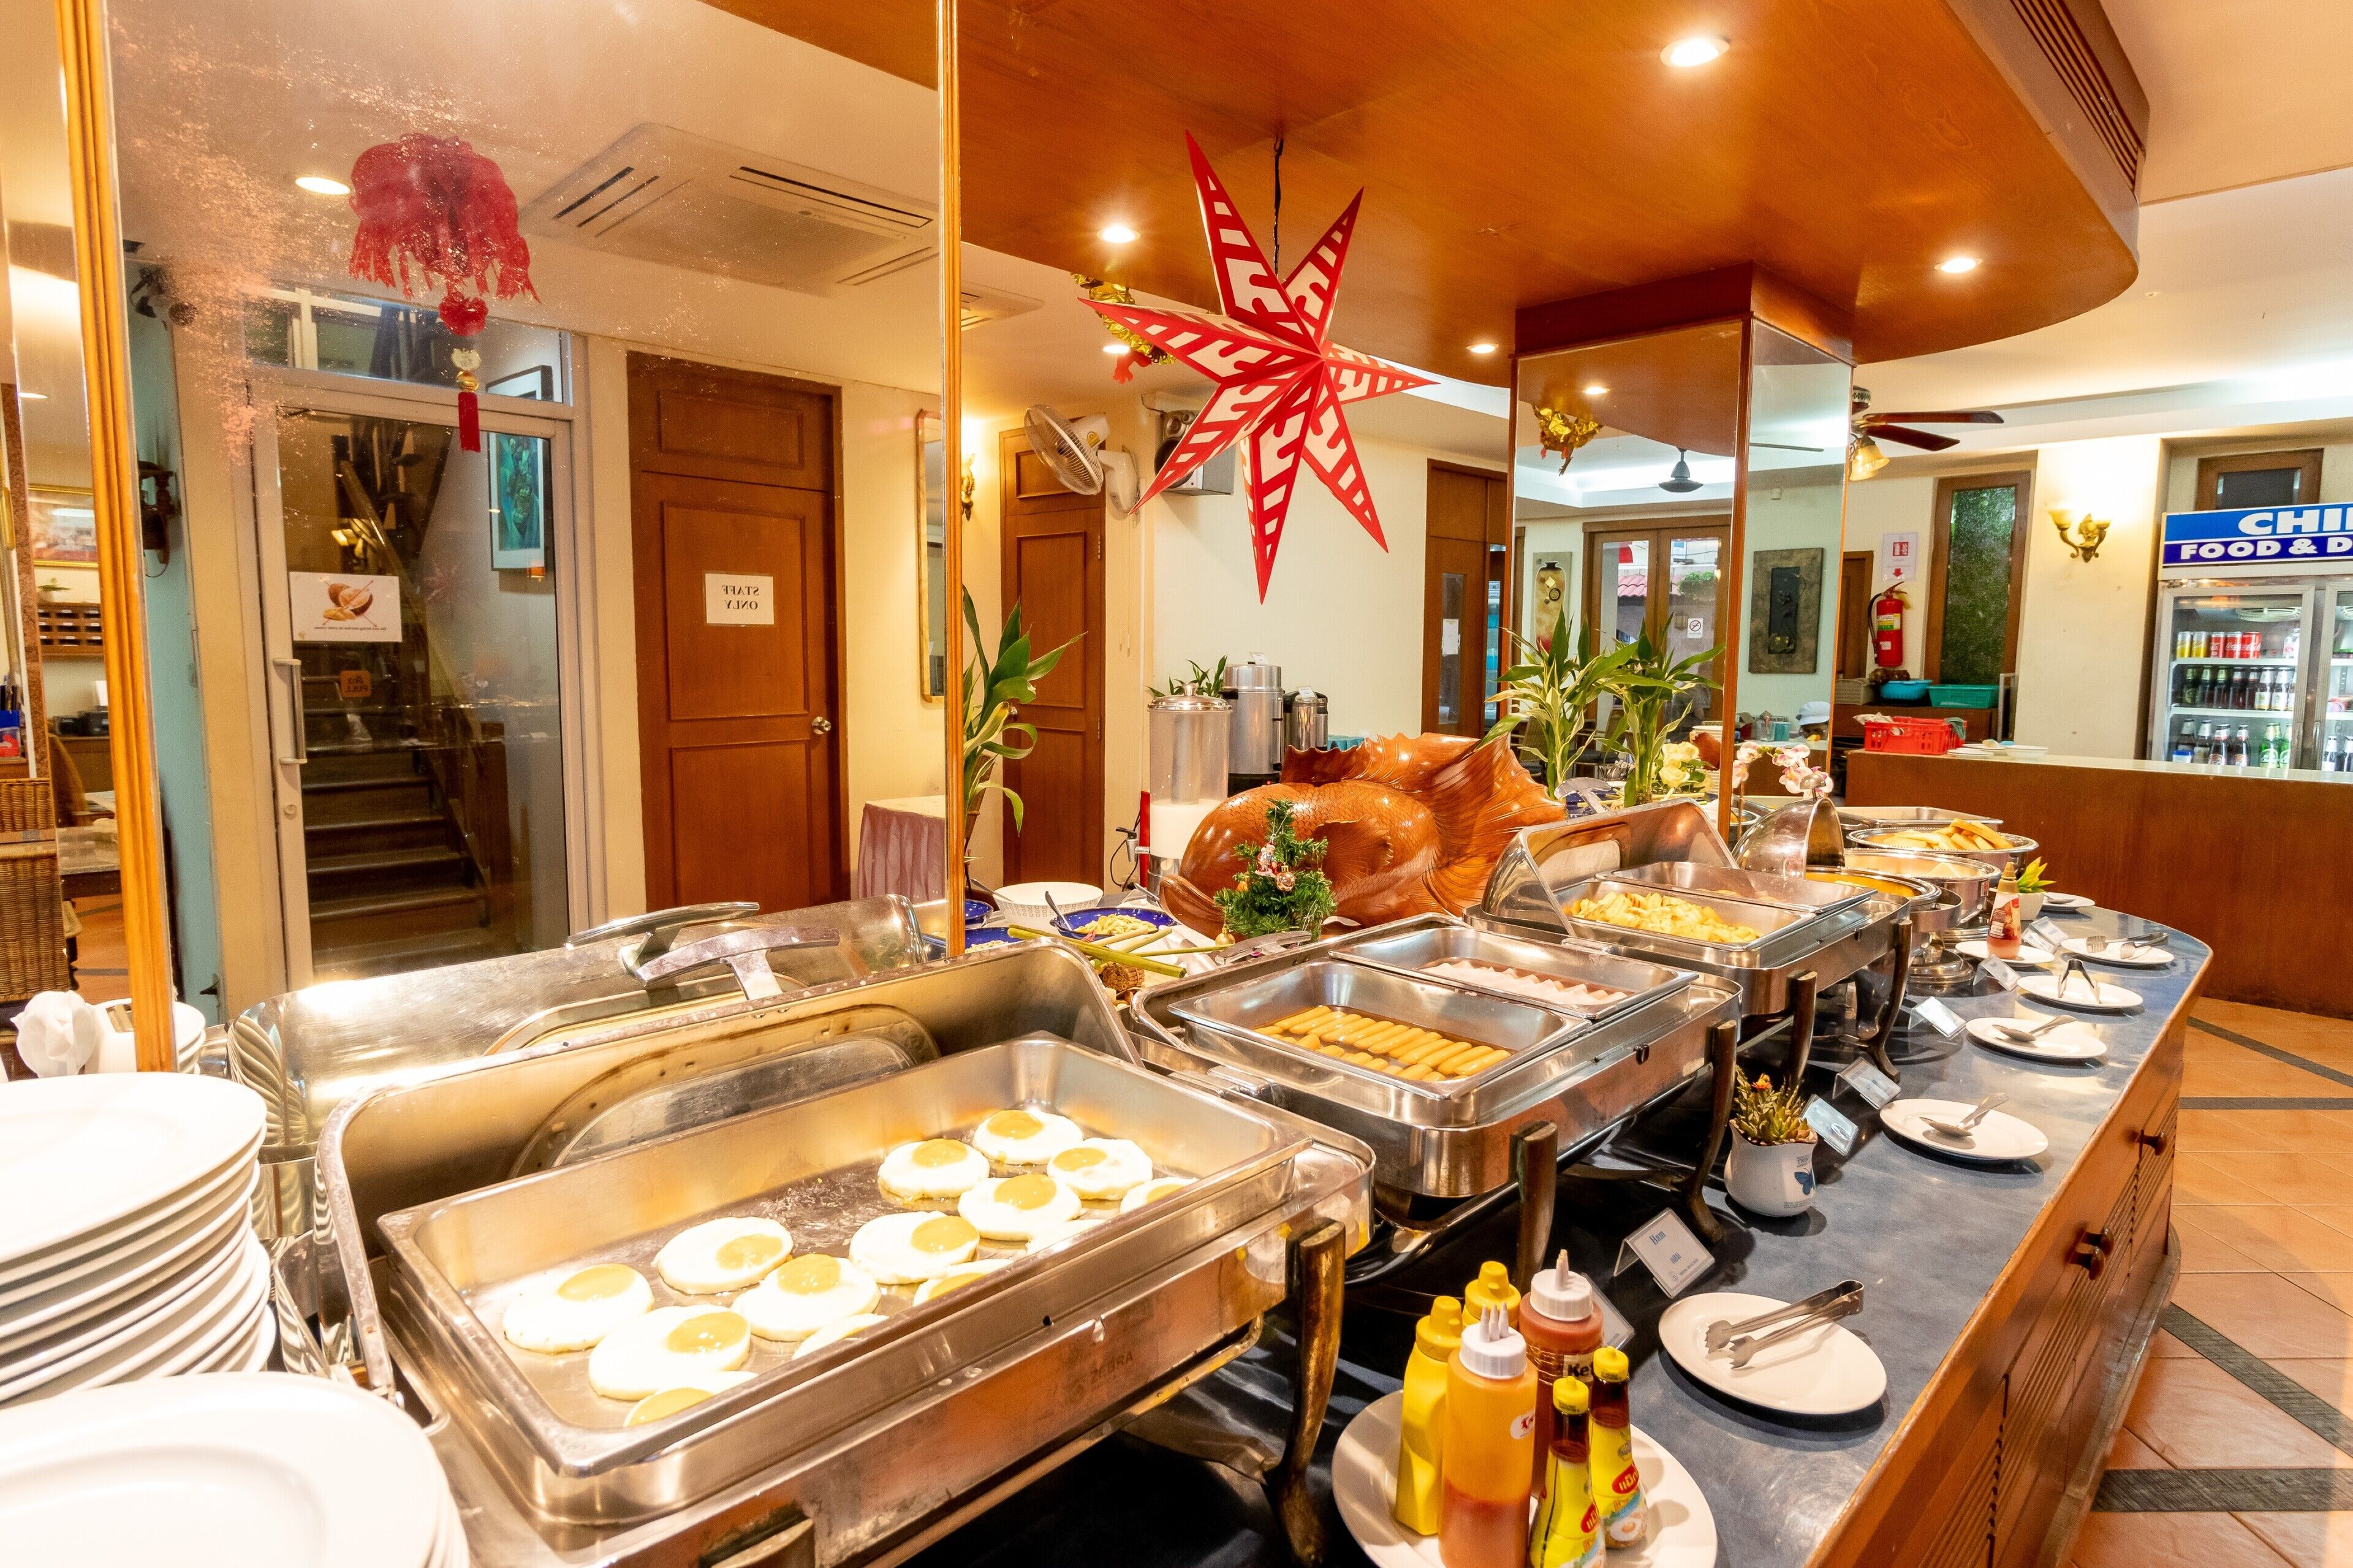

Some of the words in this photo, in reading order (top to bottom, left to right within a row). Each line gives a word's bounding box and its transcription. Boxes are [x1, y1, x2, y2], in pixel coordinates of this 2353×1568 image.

[2238, 507, 2353, 536] CHI
[2180, 540, 2281, 560] FOOD
[2288, 538, 2318, 555] &
[1649, 1230, 1667, 1245] Ham
